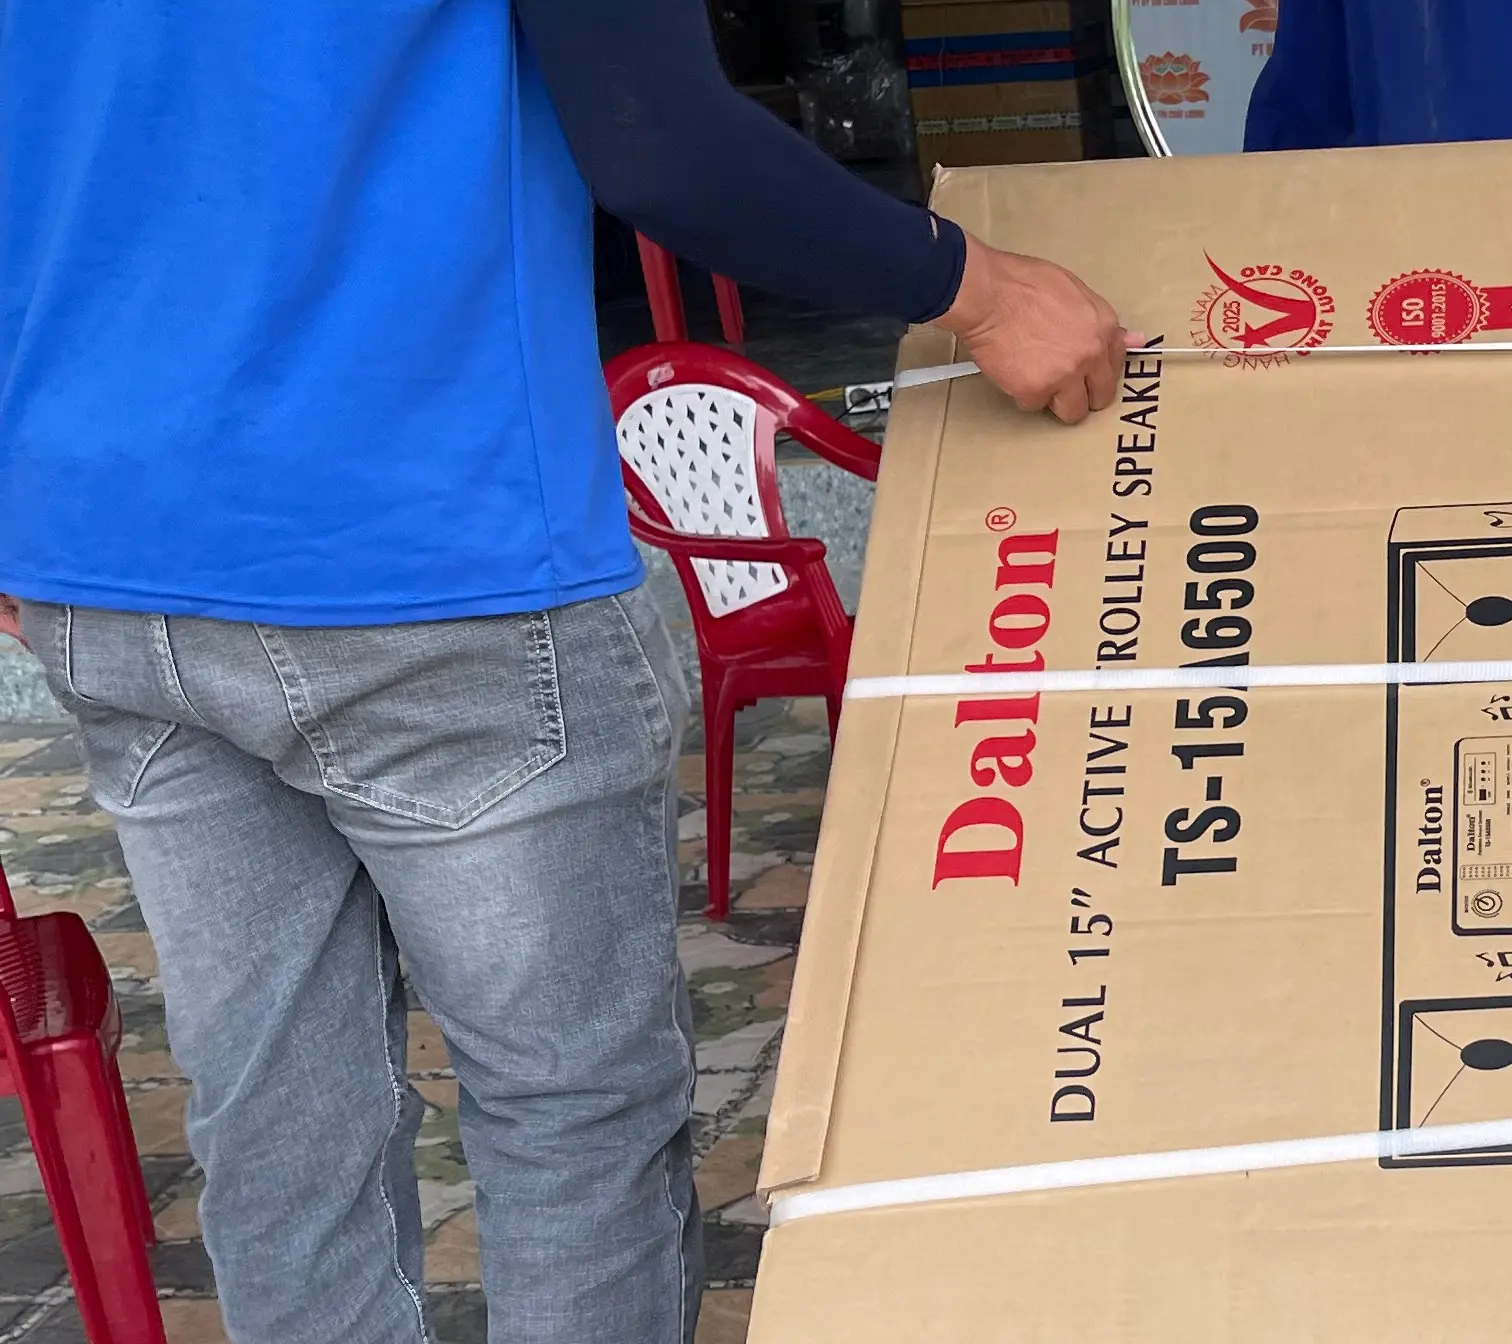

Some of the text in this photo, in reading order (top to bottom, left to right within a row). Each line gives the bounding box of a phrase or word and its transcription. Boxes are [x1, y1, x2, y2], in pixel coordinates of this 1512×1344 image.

[1239, 264, 1283, 278] CAO
[1222, 300, 1241, 334] 2025
[1401, 296, 1426, 328] ISO
[1429, 283, 1448, 339] 9001:2015
[1095, 512, 1150, 671] ROLLEY
[1076, 704, 1133, 869] ACTIVE
[1050, 984, 1107, 1123] DUAL
